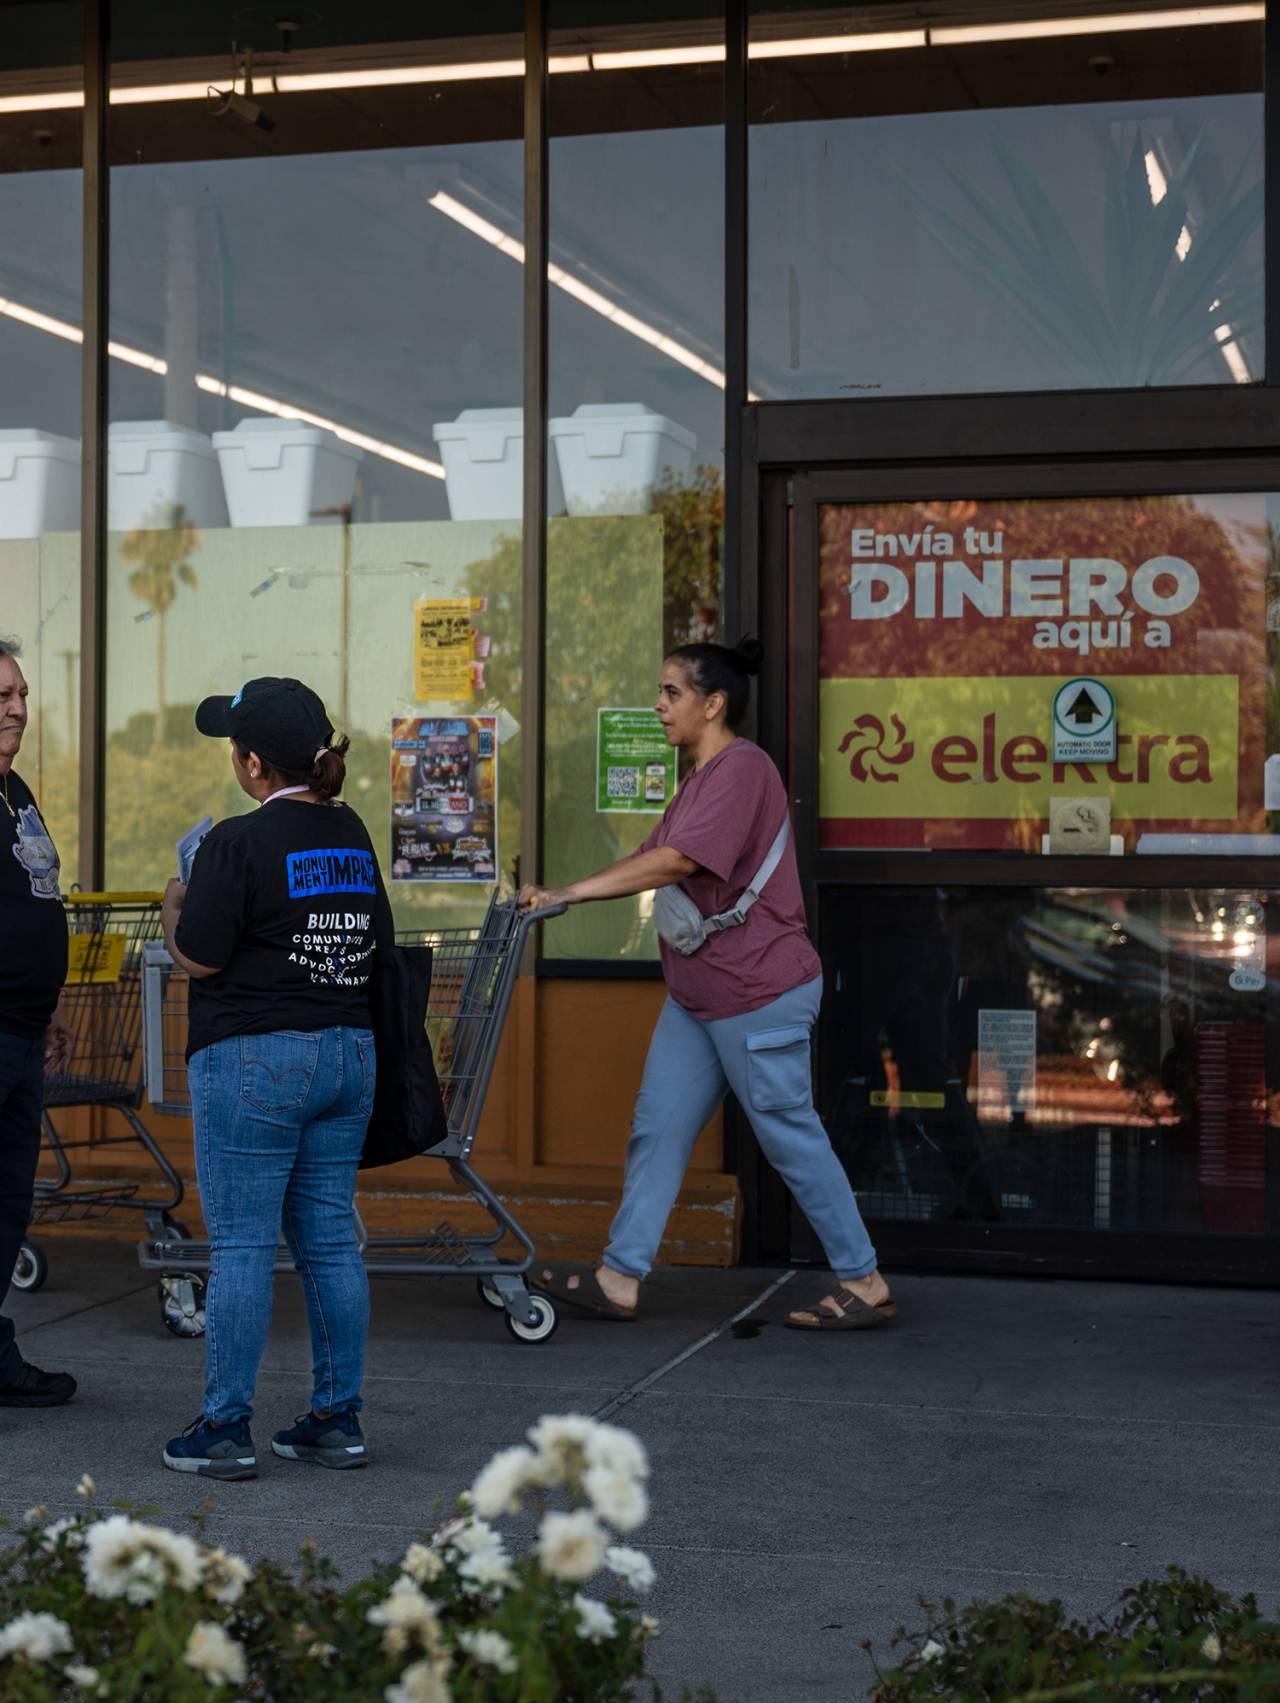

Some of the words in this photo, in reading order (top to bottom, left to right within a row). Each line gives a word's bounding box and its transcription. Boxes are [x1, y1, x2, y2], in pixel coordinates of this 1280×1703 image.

[851, 525, 954, 558] Envía
[965, 525, 1003, 555] tu
[850, 555, 1200, 620] DINERO
[1032, 611, 1135, 656] aquí
[1144, 619, 1171, 648] a
[1059, 748, 1078, 756] KEEP
[1080, 748, 1110, 756] MOVING
[292, 856, 327, 875] MONU
[293, 871, 328, 891] MENT
[307, 912, 370, 930] BUILDING
